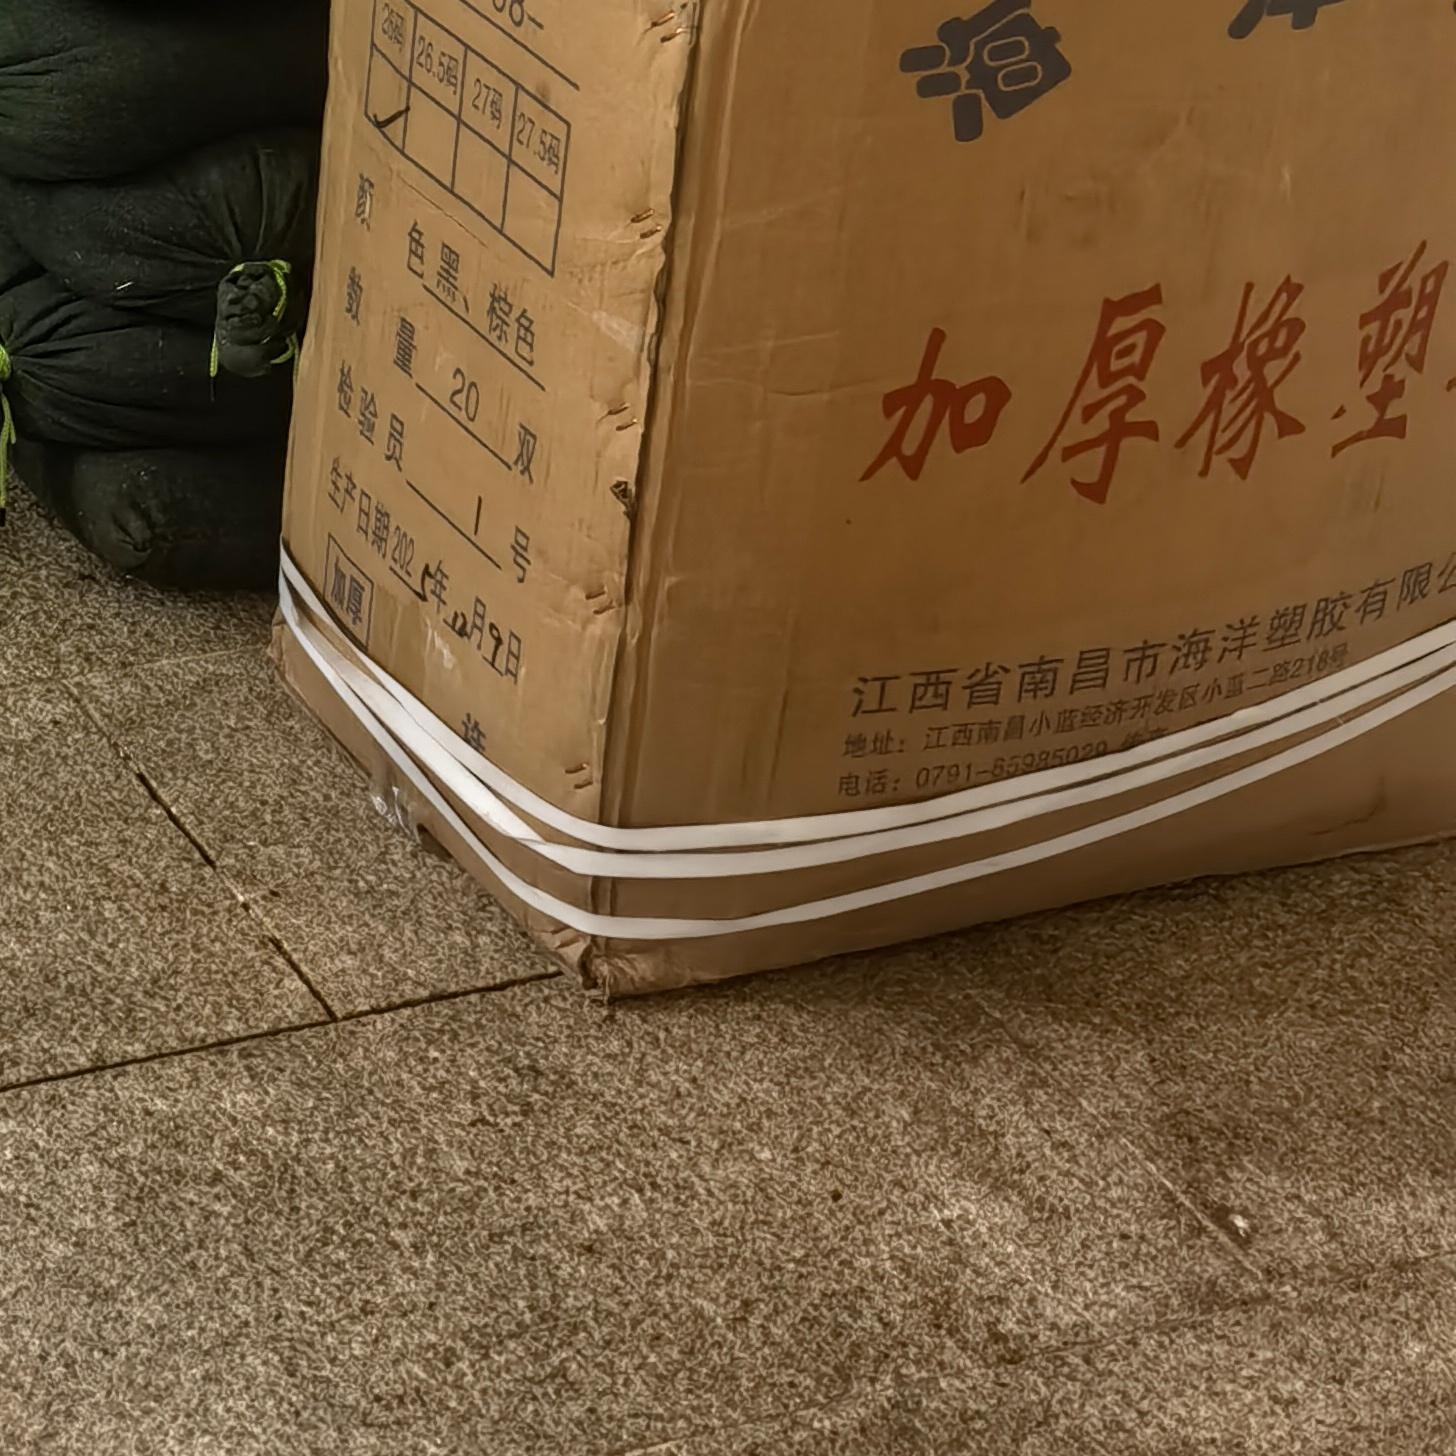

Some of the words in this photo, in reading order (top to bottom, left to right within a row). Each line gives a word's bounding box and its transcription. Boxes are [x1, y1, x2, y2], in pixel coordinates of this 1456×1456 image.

[415, 34, 460, 96] 26.5码
[471, 77, 503, 130] 27码
[858, 239, 1450, 506] 加厚橡塑
[448, 367, 480, 423] 20
[513, 422, 537, 485] 双
[331, 554, 366, 627] 加厚
[510, 525, 532, 584] 号
